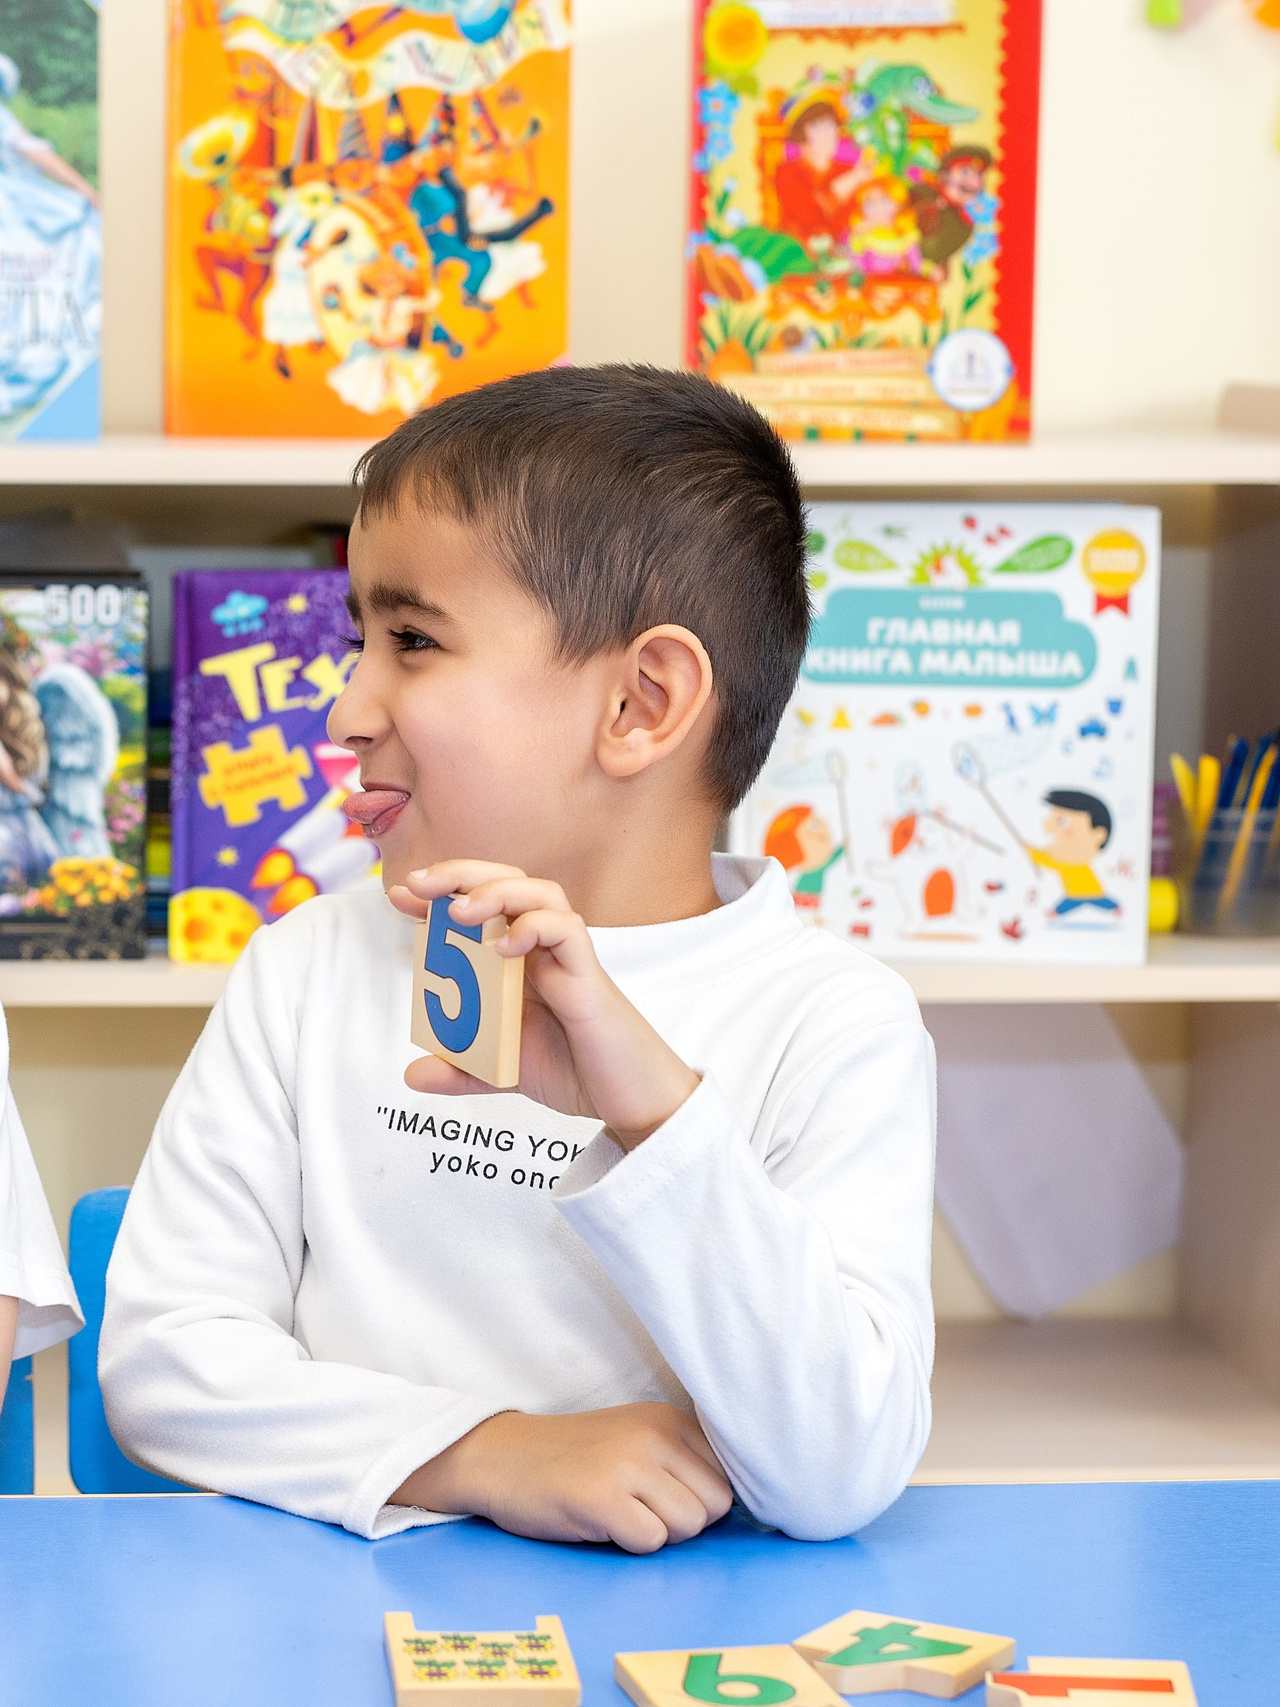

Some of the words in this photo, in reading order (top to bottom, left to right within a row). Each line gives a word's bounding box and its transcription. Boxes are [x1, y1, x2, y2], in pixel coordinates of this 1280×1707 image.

[44, 583, 121, 627] 500
[867, 616, 1022, 646] ГЛАВНАЯ
[805, 647, 914, 675] КНИГА
[919, 647, 1083, 678] МАЛЫША
[424, 896, 482, 1053] 5
[429, 1152, 498, 1180] yoko
